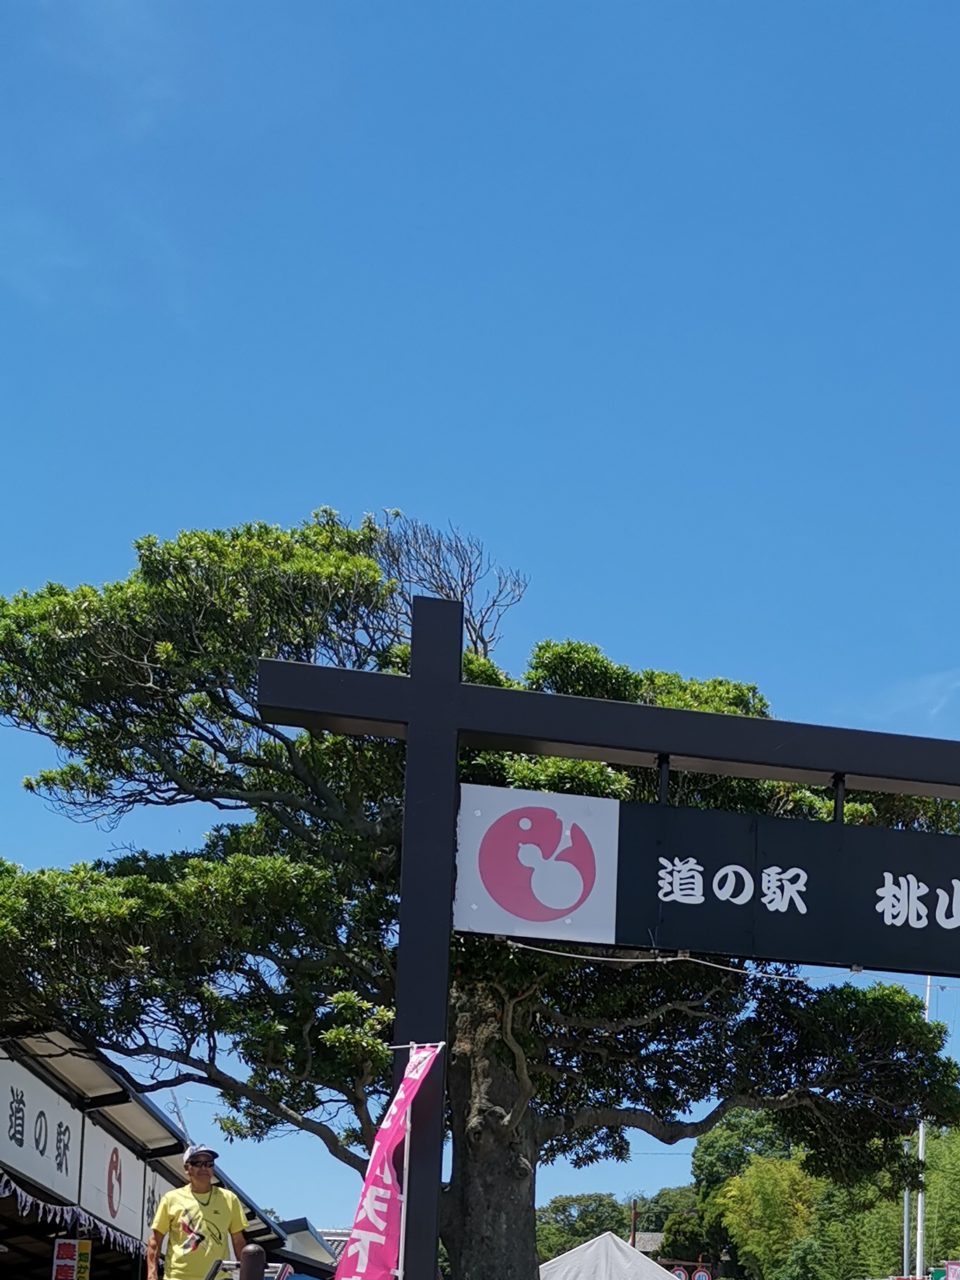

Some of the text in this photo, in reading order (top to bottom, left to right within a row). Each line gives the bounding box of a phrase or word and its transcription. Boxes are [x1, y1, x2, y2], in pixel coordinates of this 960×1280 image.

[657, 856, 810, 915] 道の駅
[8, 1085, 71, 1177] 道の駅
